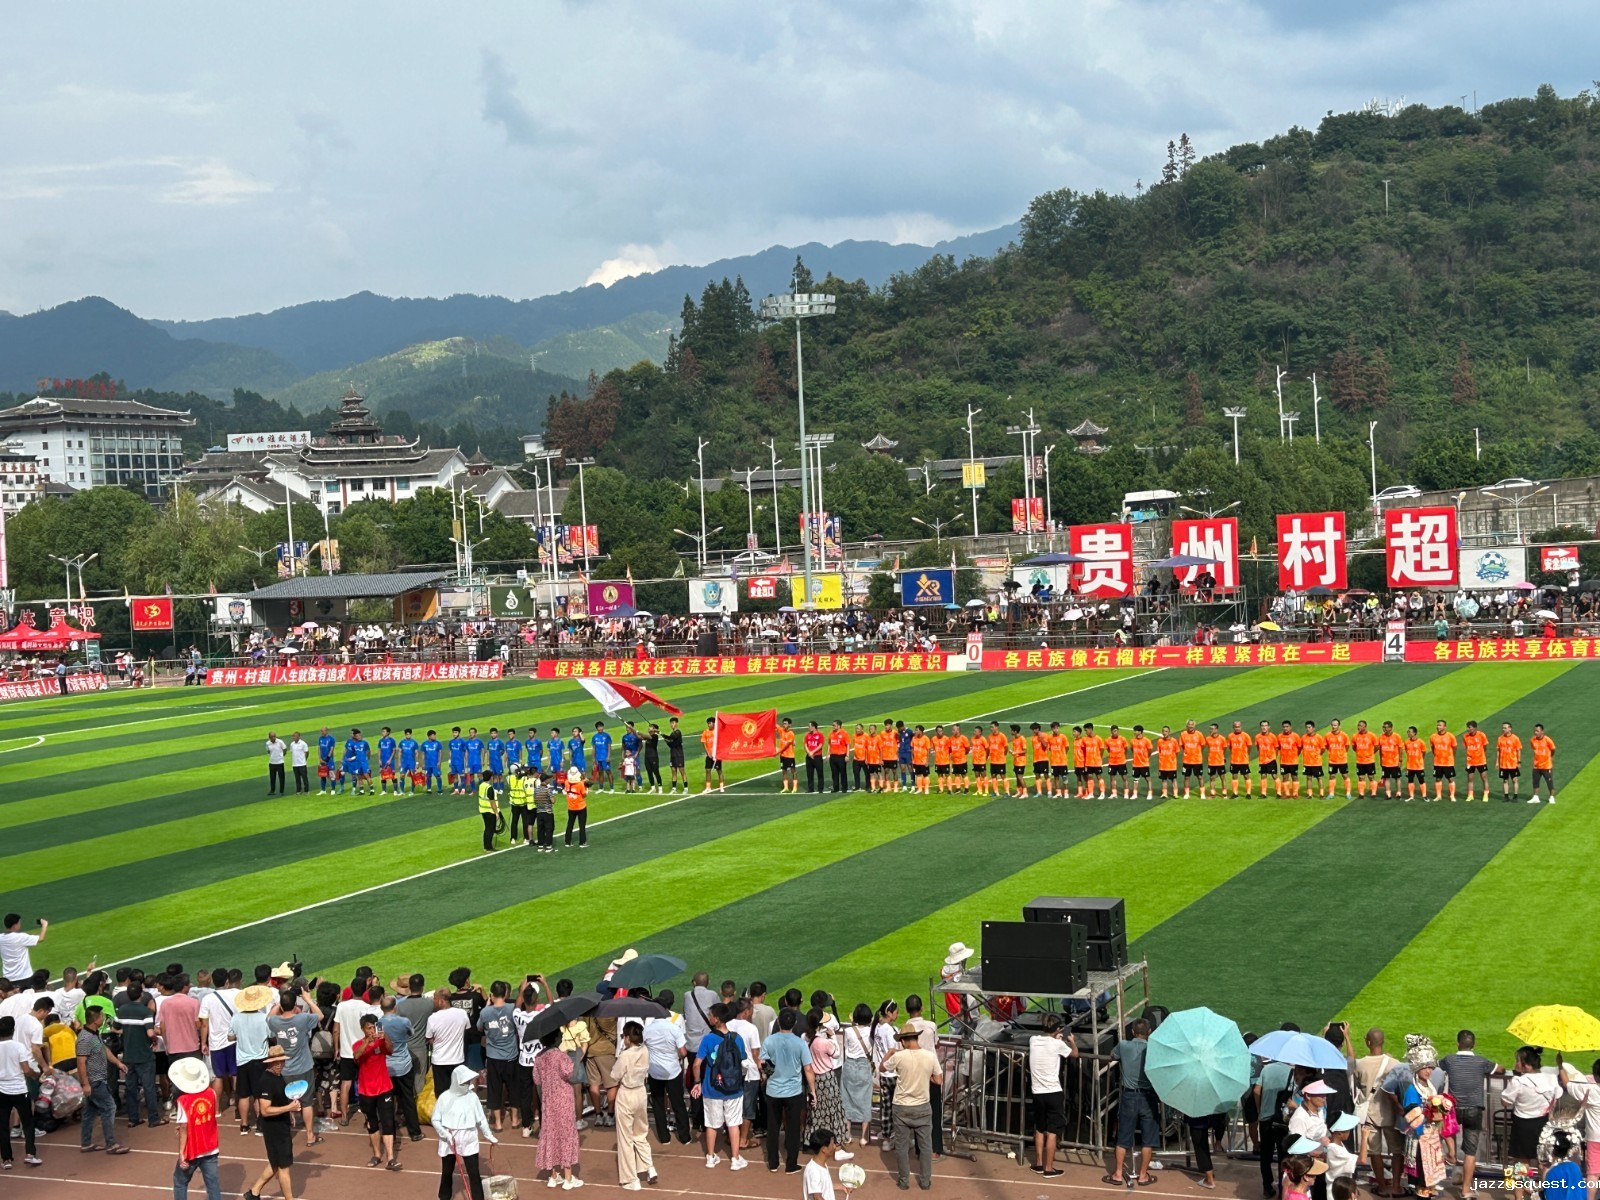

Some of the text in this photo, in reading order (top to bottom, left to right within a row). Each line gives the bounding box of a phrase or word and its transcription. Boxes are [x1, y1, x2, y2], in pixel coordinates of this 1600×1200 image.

[1075, 513, 1453, 594] 贵州村超
[968, 645, 979, 661] 0
[1388, 633, 1402, 652] 4
[555, 654, 942, 677] 促进各民族交往交流交融 铸牢中华民族共同体意识
[1004, 643, 1351, 668] 各民族像石榴籽一样紧紧抱在一起
[352, 666, 422, 682] 人生就该有追求
[427, 663, 500, 679] 人生就该有追求
